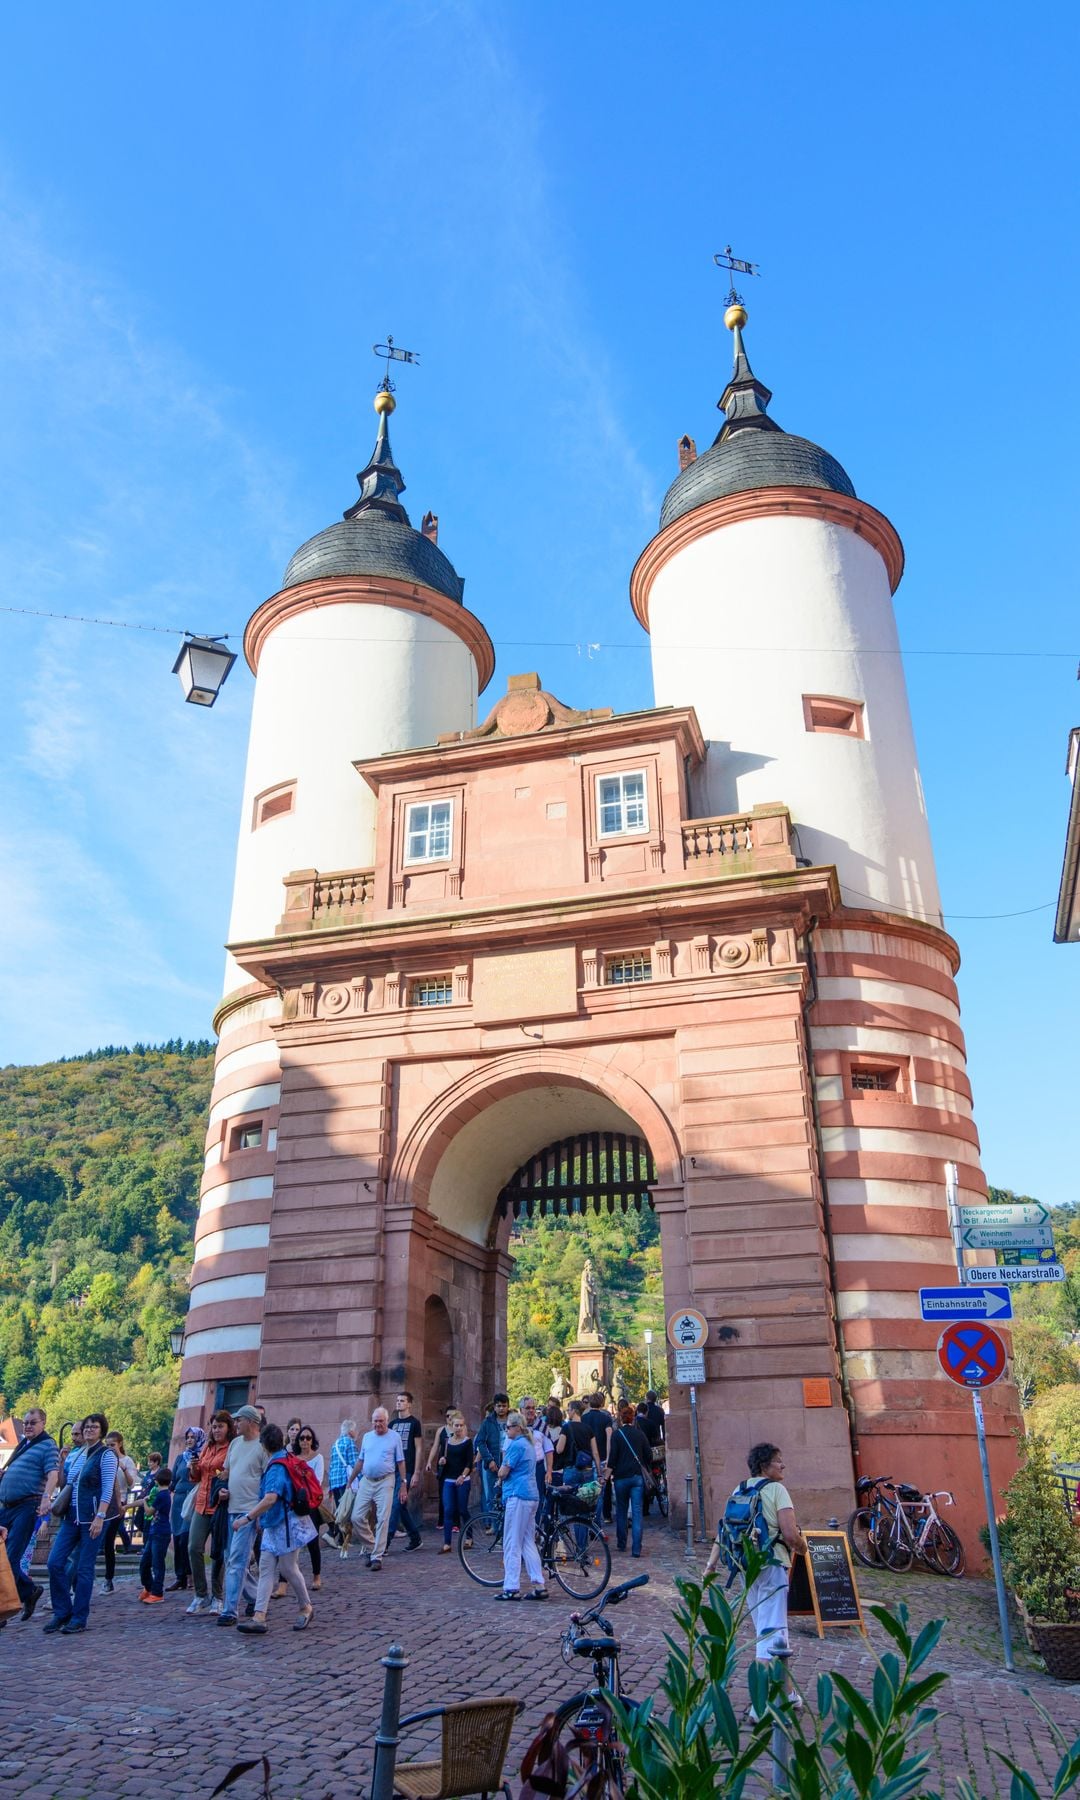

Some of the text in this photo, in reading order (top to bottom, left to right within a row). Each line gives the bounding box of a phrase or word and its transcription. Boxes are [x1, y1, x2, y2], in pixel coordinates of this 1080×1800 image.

[970, 1267, 1060, 1280] Obere Neckarstraße
[926, 1299, 988, 1309] Einbahnstraße
